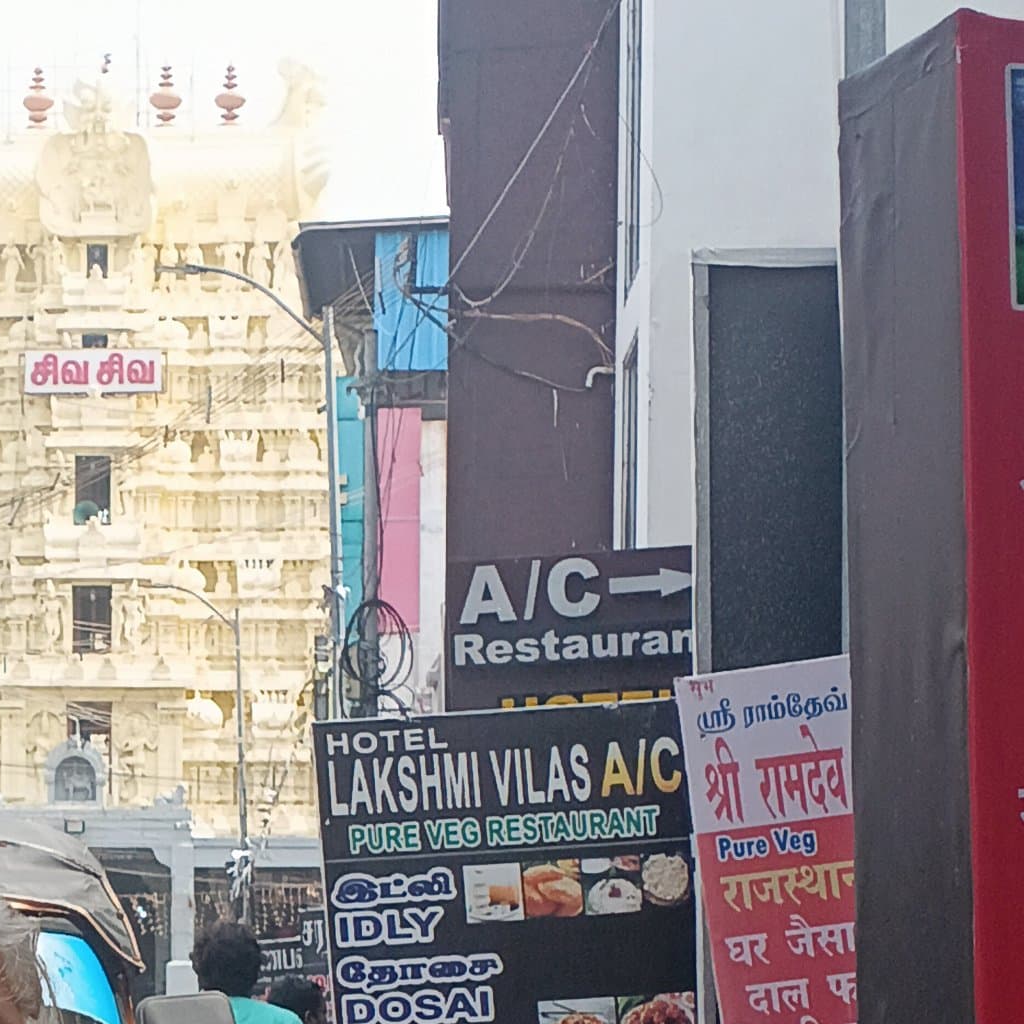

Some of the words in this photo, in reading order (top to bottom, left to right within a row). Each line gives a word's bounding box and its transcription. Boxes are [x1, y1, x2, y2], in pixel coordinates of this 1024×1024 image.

[31, 353, 89, 386] சிவ
[96, 353, 155, 385] சிவ
[460, 557, 601, 624] A/C
[454, 629, 692, 666] Restauran
[697, 698, 736, 734] ஸ்ரீ
[743, 686, 848, 729] ராம்தேவ்
[326, 728, 448, 755] HOTEL
[328, 752, 481, 816] LAKSHMI
[489, 744, 592, 803] VILAS
[601, 736, 682, 797] A/C
[705, 736, 744, 823] श्री
[754, 724, 848, 819] रामदेव
[349, 821, 422, 854] PURE
[424, 817, 481, 850] VEG
[486, 805, 660, 846] RESTAURANT
[716, 835, 769, 862] Pure
[772, 826, 816, 856] Veg
[331, 866, 457, 908] இட்லி
[335, 906, 444, 948] IDLY
[725, 932, 770, 967] घर
[785, 913, 855, 958] जैसा
[336, 953, 503, 993] தோசை
[745, 978, 809, 1015] दाल
